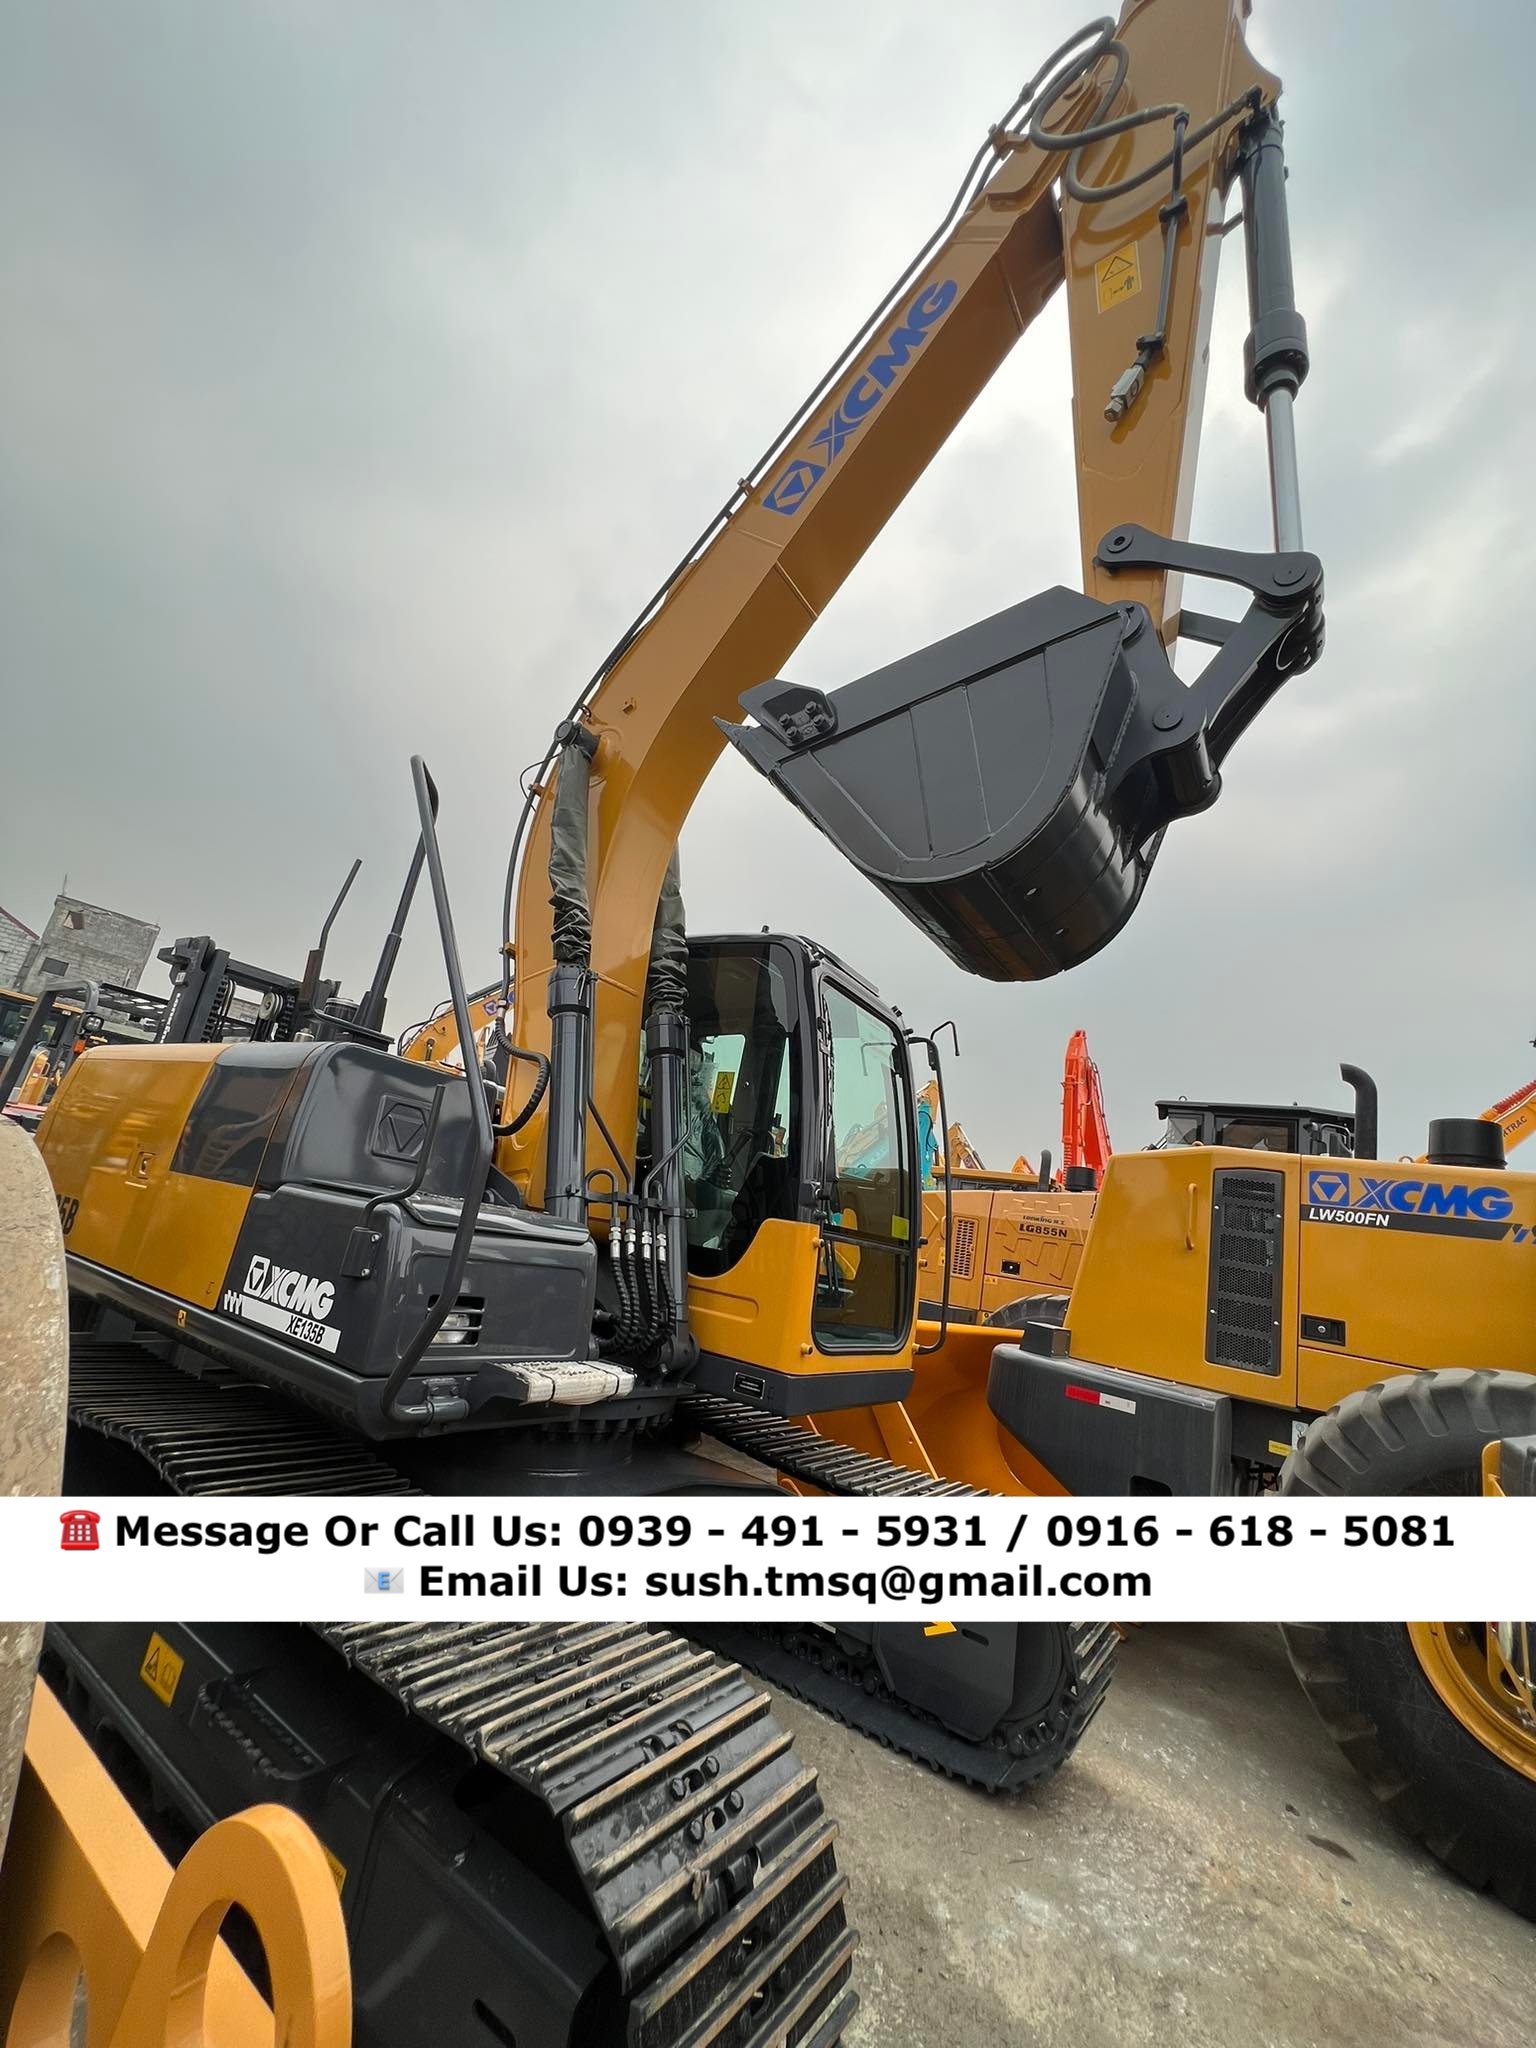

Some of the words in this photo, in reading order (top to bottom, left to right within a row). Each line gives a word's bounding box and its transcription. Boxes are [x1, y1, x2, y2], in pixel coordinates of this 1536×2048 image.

[808, 280, 958, 467] XCMG
[1309, 1207, 1390, 1227] LW500FN
[1351, 1177, 1514, 1220] XCMG
[1019, 1223, 1068, 1238] LG855N
[259, 1265, 336, 1321] XCMG
[285, 1314, 326, 1345] XE135B
